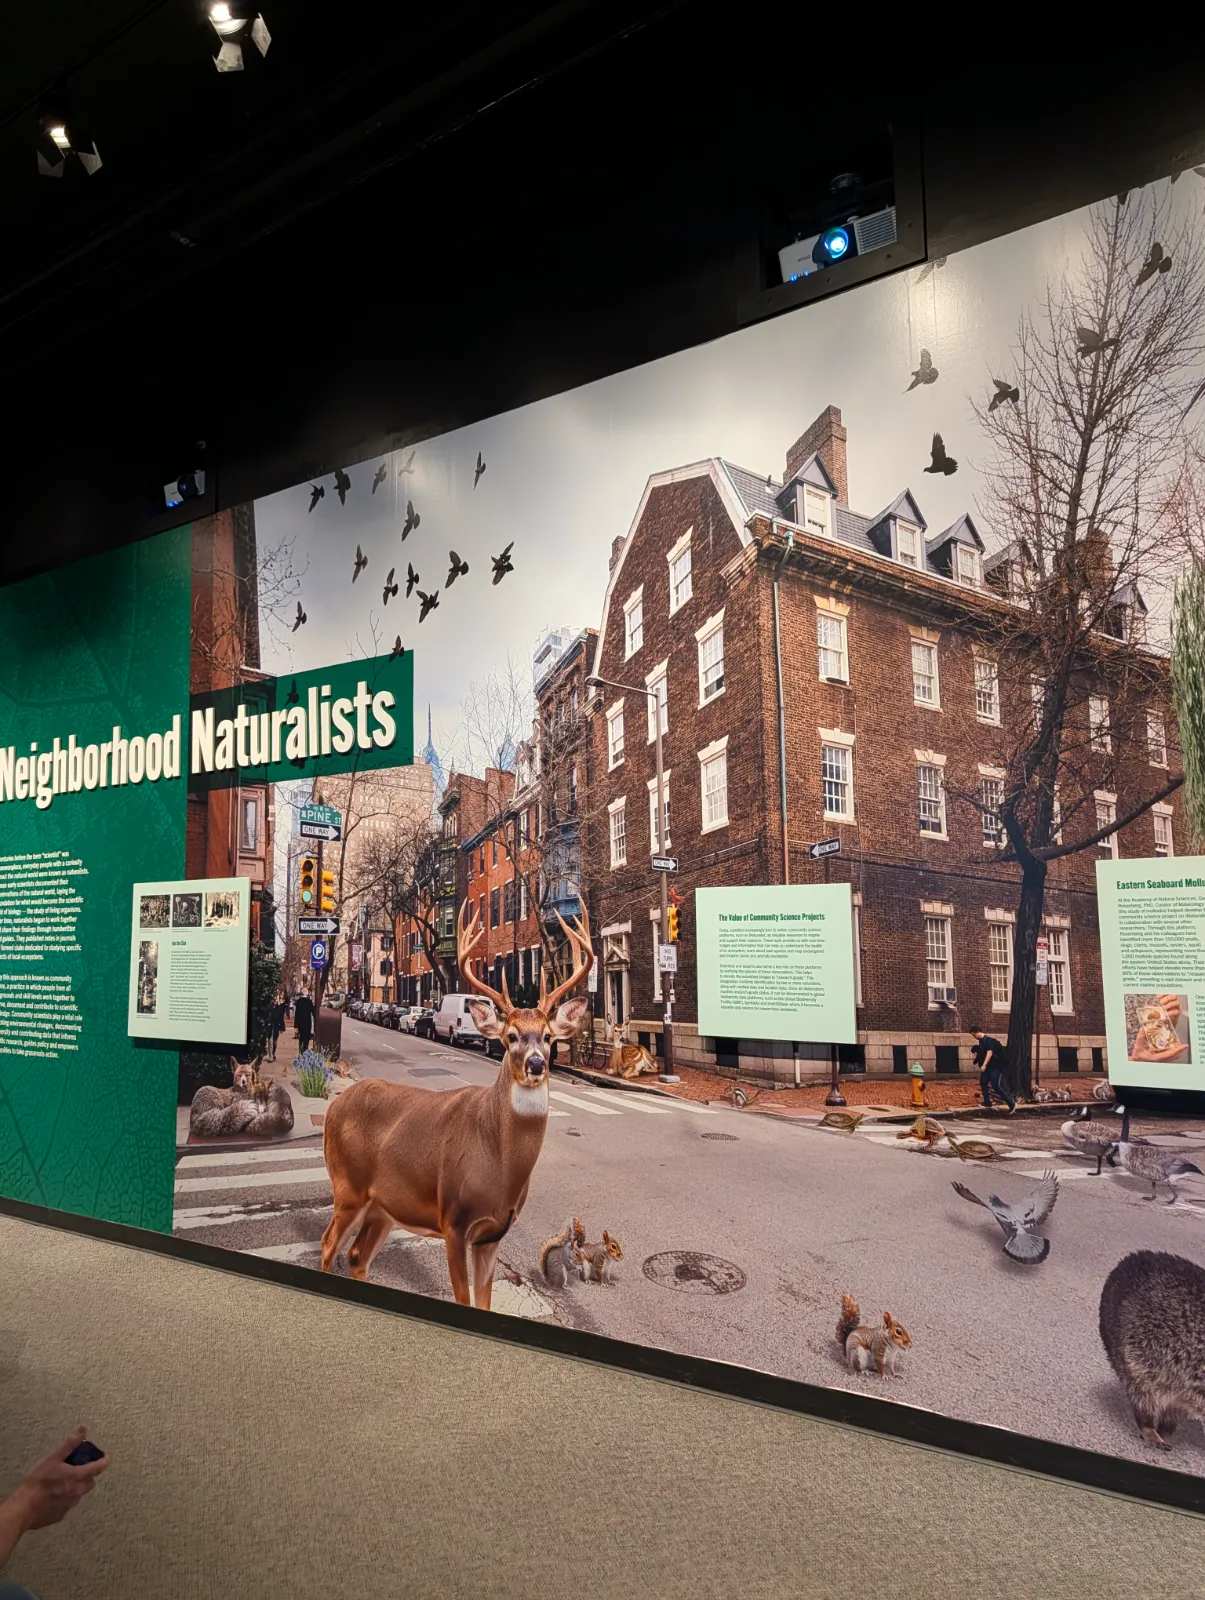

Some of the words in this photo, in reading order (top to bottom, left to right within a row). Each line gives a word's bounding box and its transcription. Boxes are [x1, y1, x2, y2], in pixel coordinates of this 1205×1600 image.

[0, 715, 181, 809] Neighborhood
[191, 681, 397, 774] Naturalists
[307, 810, 332, 822] PINE
[304, 826, 316, 834] ONE
[1116, 881, 1145, 890] Eastern
[1147, 879, 1183, 888] Seaboard
[750, 914, 779, 922] Community
[802, 913, 825, 922] Projects
